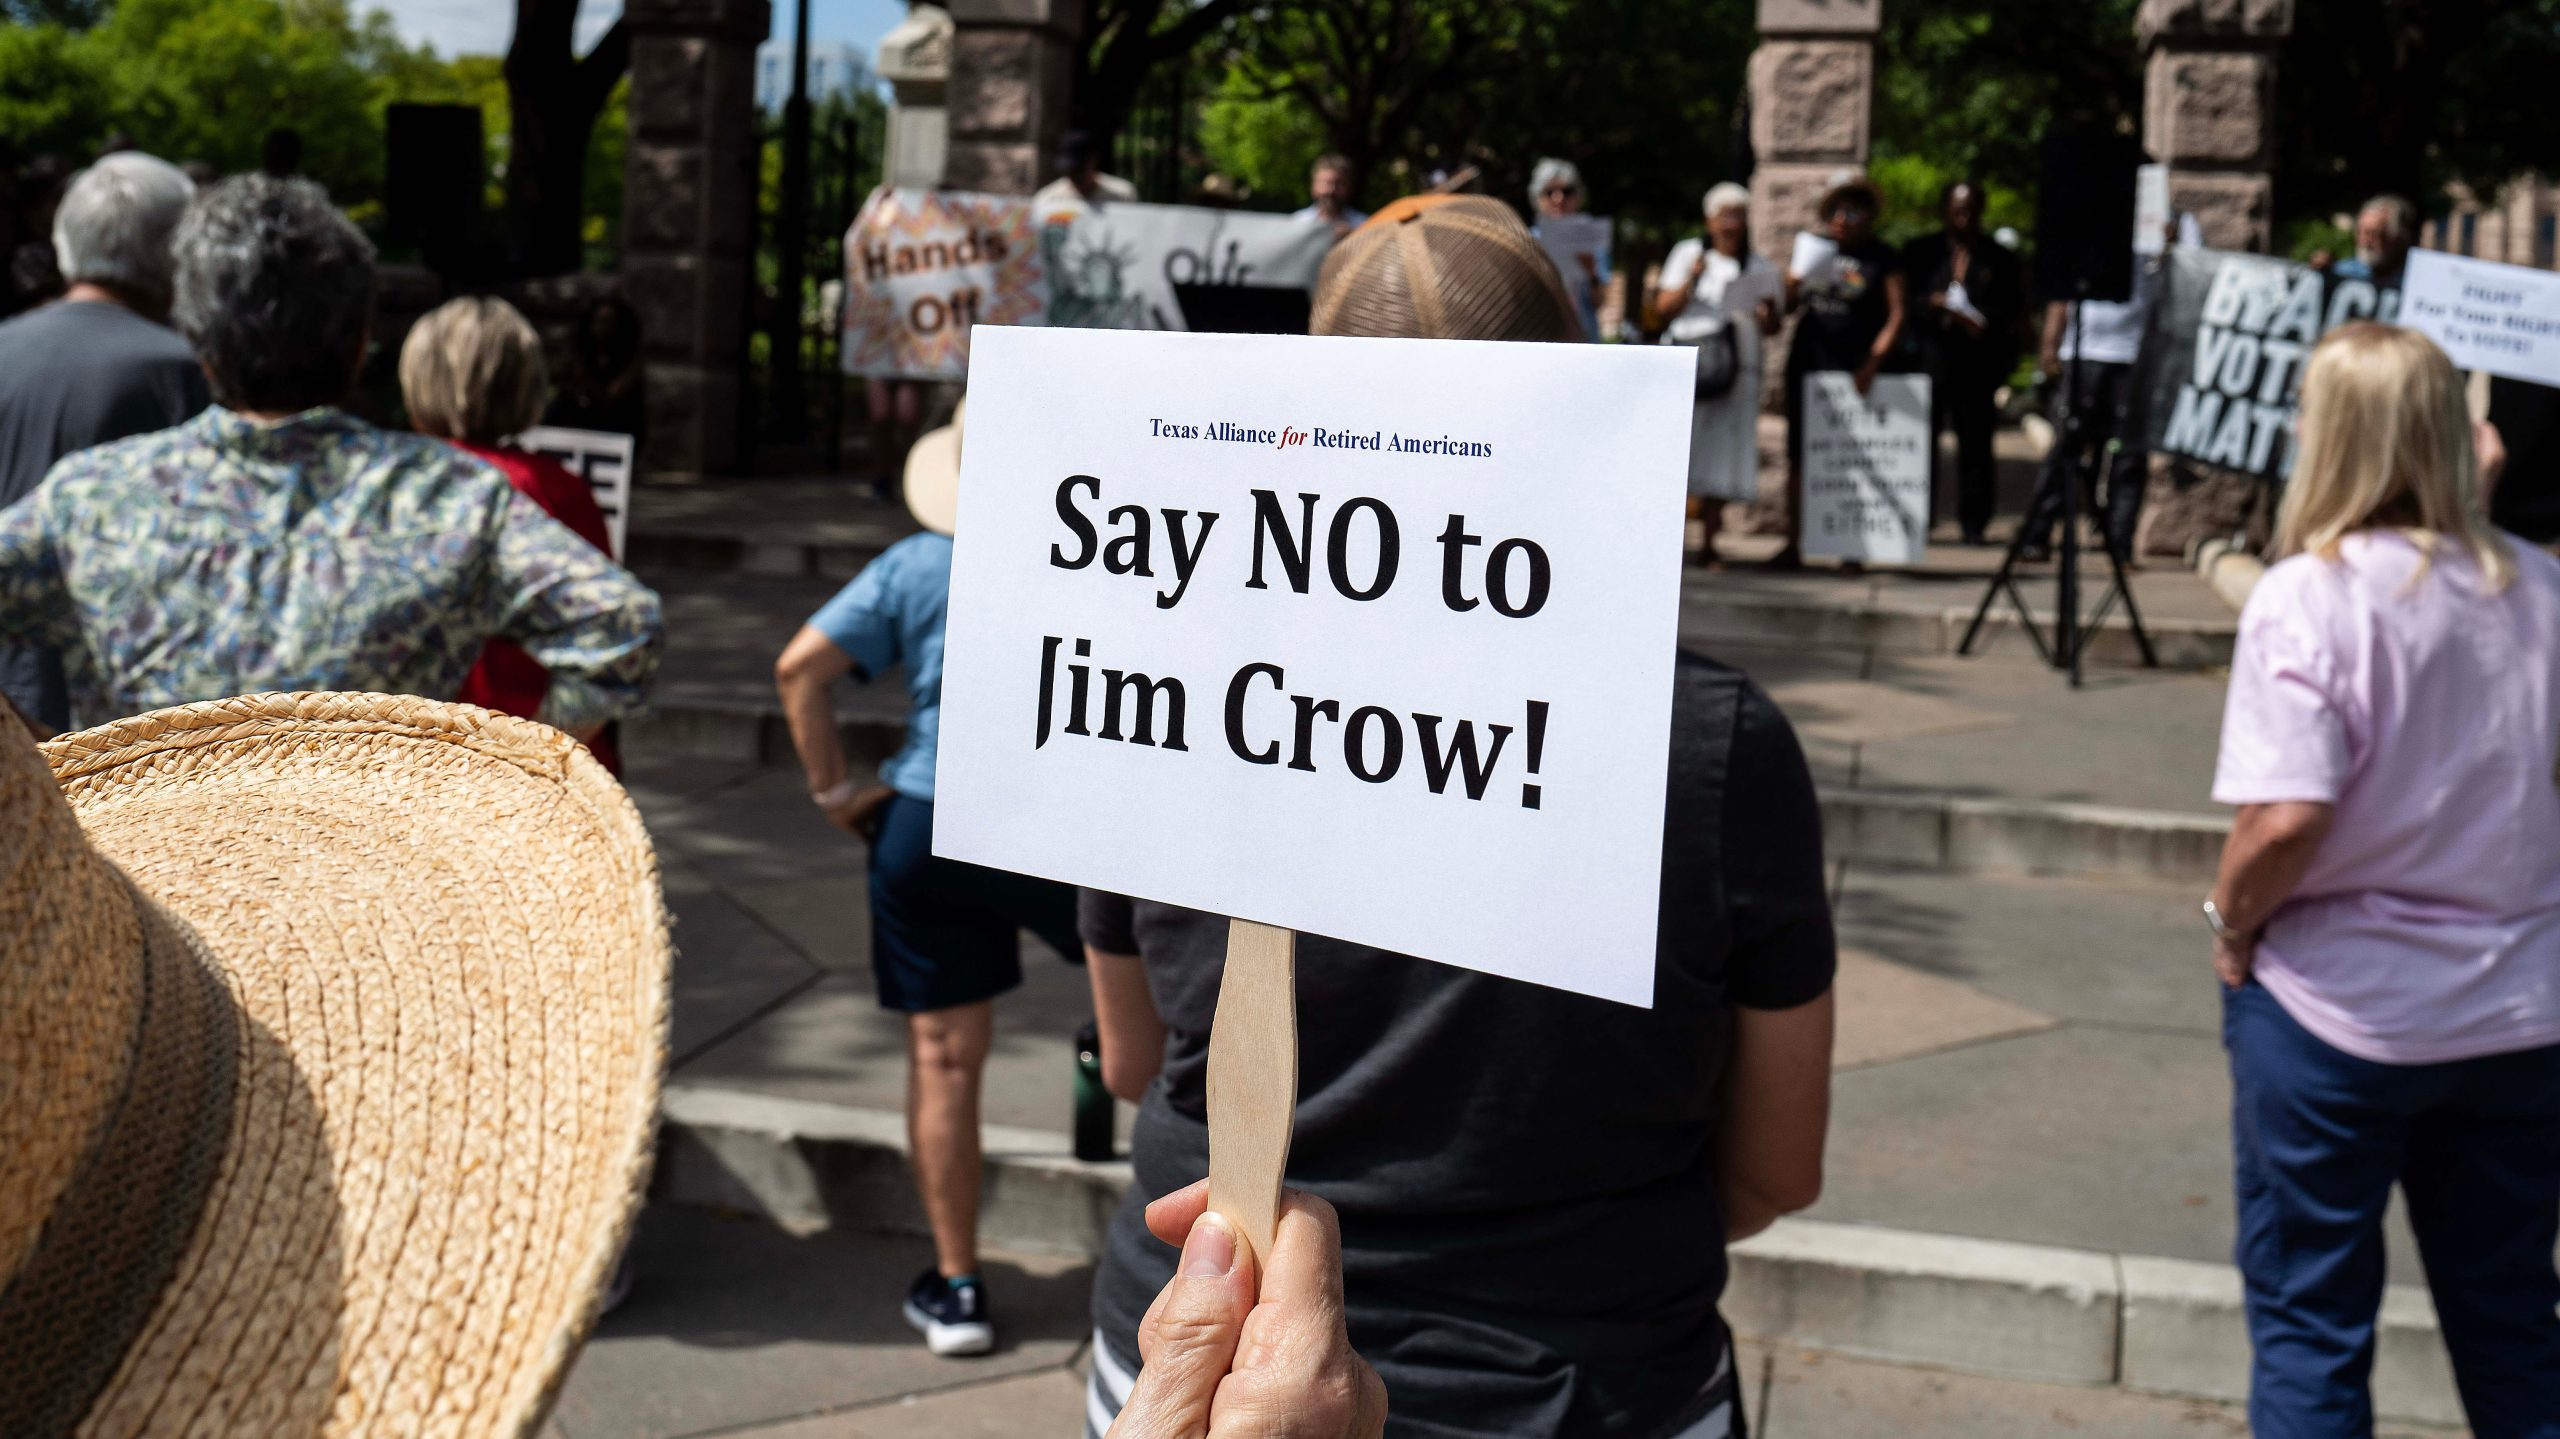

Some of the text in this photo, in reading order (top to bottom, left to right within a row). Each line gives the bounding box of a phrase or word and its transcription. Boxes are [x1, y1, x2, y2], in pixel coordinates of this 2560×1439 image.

[863, 227, 1008, 282] Hands
[911, 286, 982, 335] Off
[2193, 324, 2304, 404] VOT
[1150, 418, 1492, 459] Texas Alliance for Retired Americans
[1050, 474, 1551, 619] Say NO to
[1035, 635, 1551, 811] Jim Crow!
